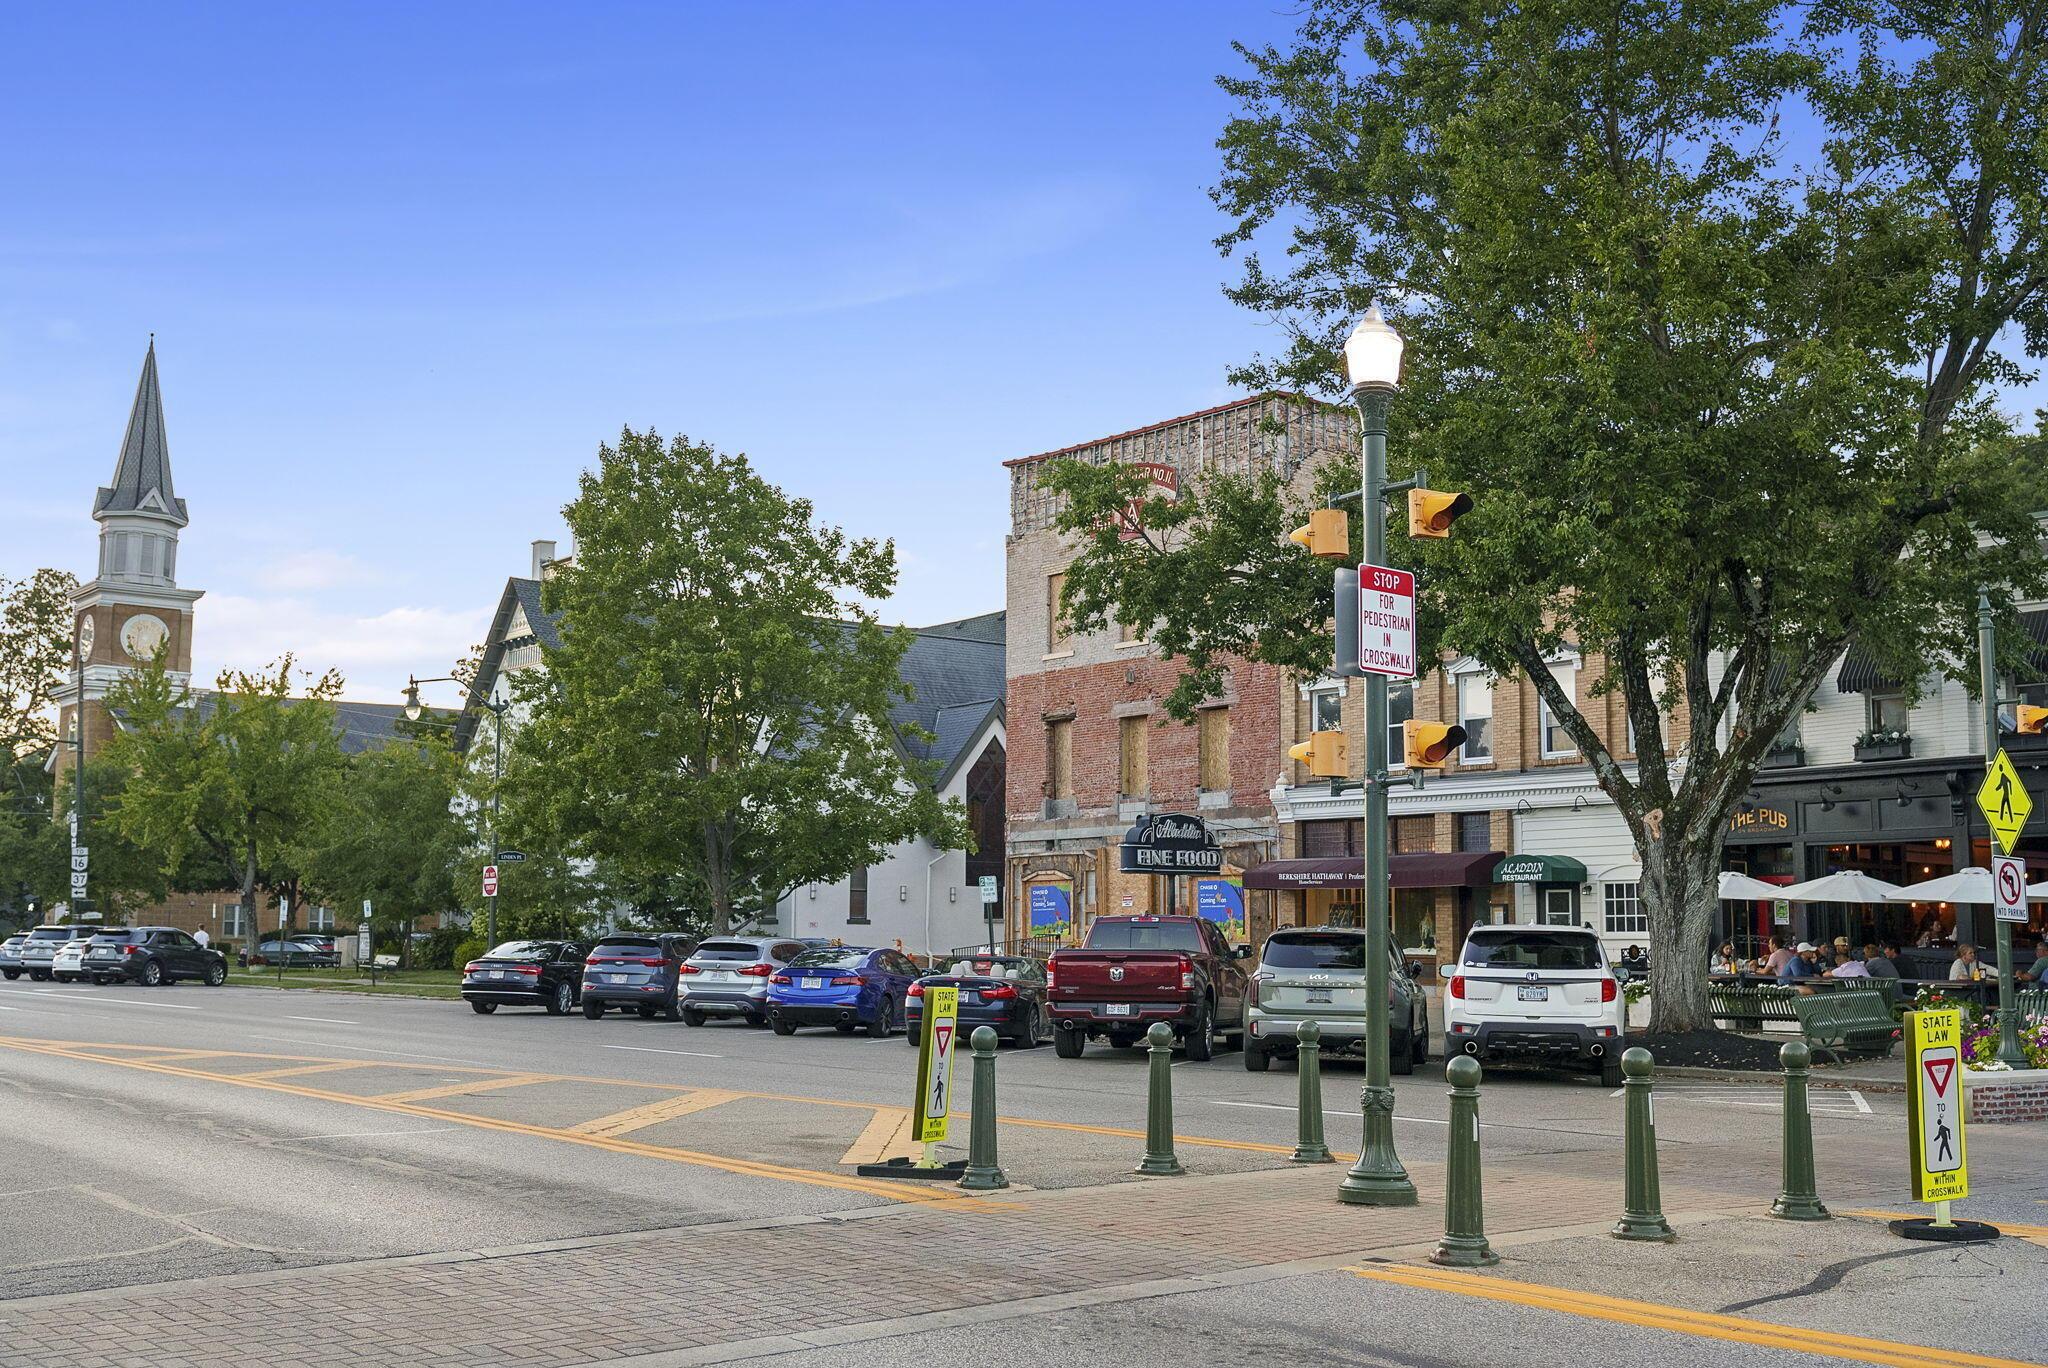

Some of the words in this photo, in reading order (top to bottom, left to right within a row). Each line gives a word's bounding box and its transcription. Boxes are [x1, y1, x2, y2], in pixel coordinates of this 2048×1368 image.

[1373, 572, 1400, 590] STOP
[1379, 594, 1394, 610] FOR
[1364, 610, 1411, 632] PEDESTRIAN
[1383, 633, 1391, 648] IN
[1363, 649, 1411, 669] CROSSWALK
[1759, 808, 1788, 829] PUB
[74, 859, 84, 868] 16
[1137, 849, 1174, 866] FINE
[1176, 850, 1221, 867] FOOD
[1501, 862, 1544, 874] ALADDIN
[73, 875, 86, 884] 37
[1311, 872, 1344, 880] HATHAWAY
[1502, 873, 1543, 881] RESTAURANT
[980, 878, 985, 886] 2
[1997, 907, 2007, 916] INTO
[2008, 908, 2026, 918] PARKING
[937, 991, 955, 1002] STATE
[939, 1003, 952, 1013] LAW
[1922, 1015, 1953, 1029] STATE
[1927, 1030, 1949, 1043] LAW
[938, 1062, 944, 1070] TO
[1937, 1103, 1946, 1112] TO
[1934, 1175, 1956, 1185] WITHIN
[1927, 1187, 1964, 1199] CROSSWALK
